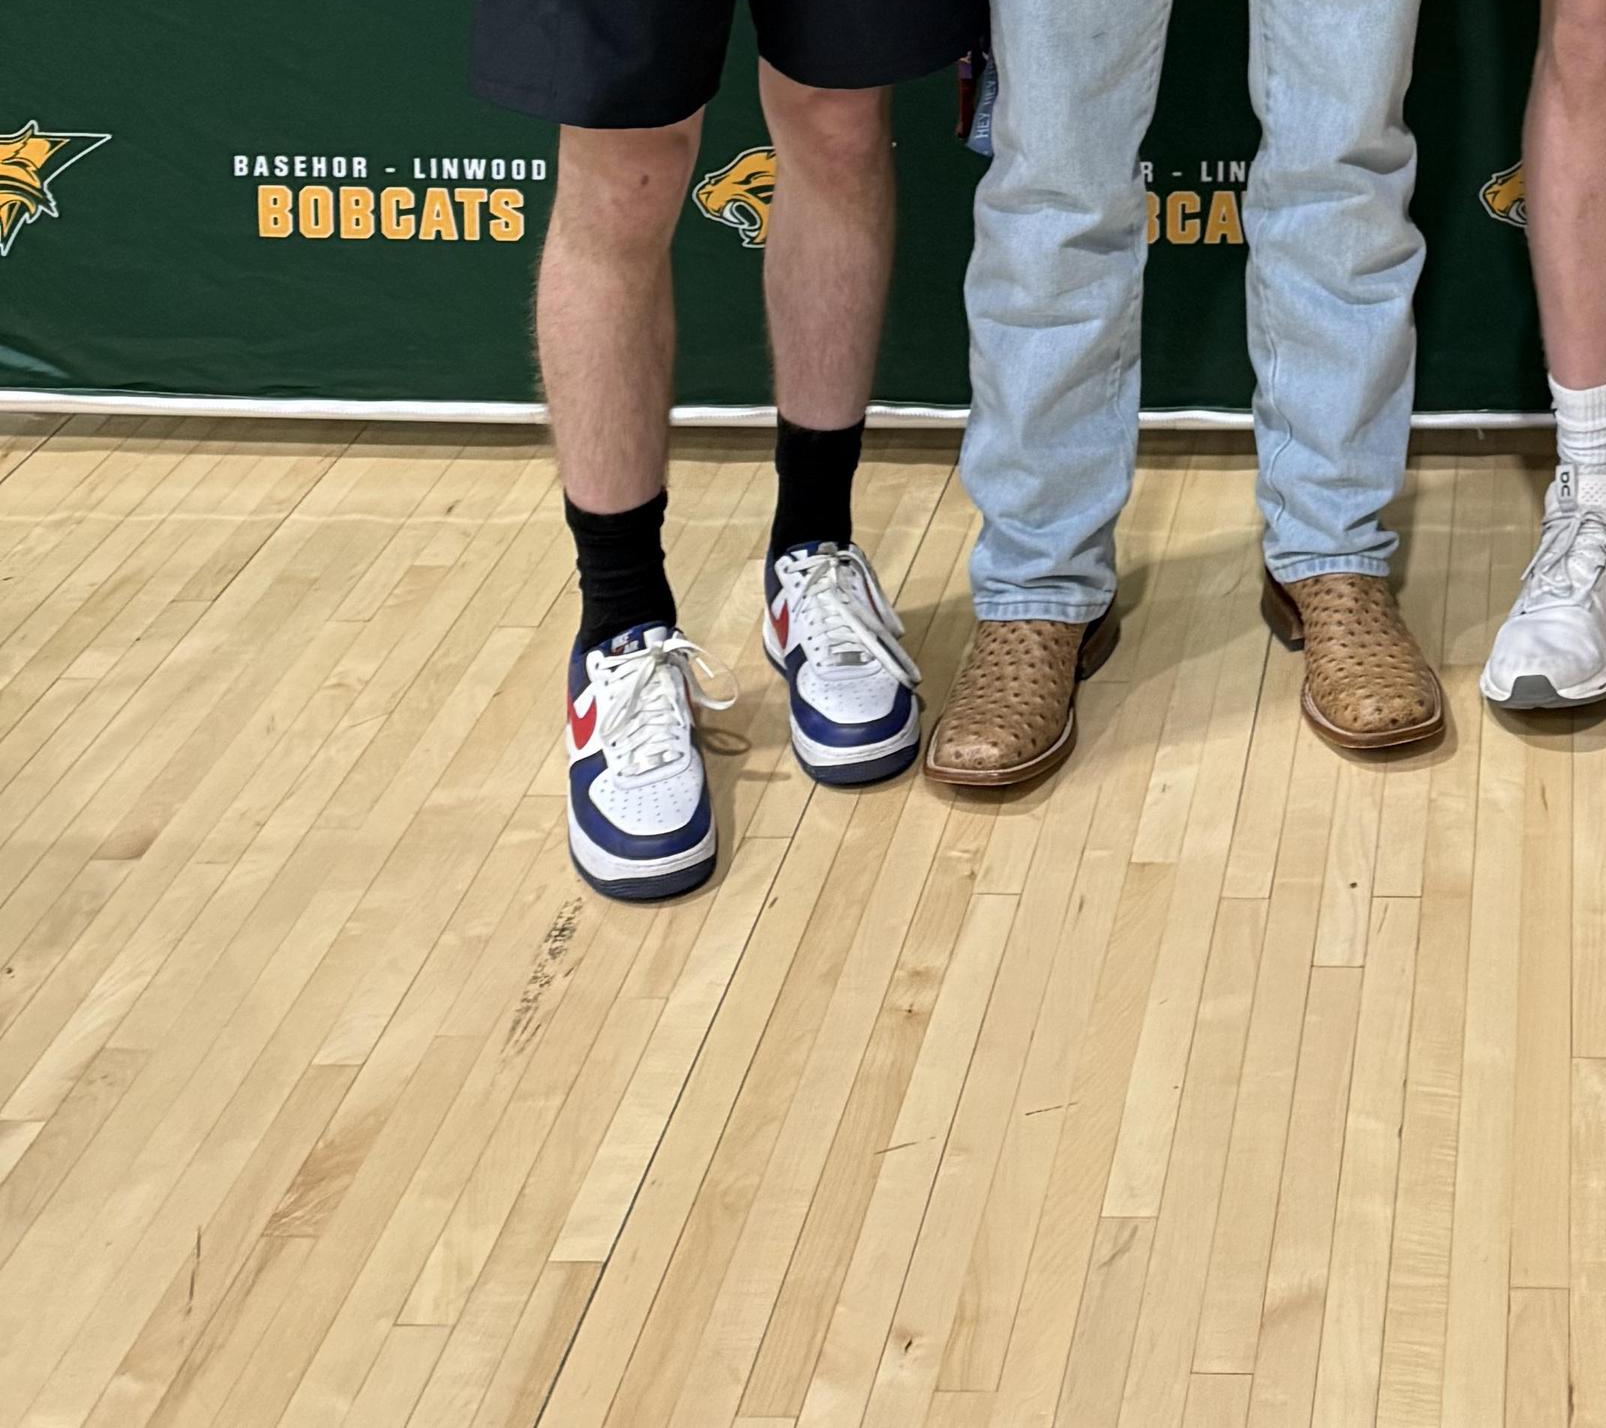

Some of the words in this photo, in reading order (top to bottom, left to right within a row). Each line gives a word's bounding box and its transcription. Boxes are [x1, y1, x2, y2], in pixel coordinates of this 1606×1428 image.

[233, 154, 368, 178] BASEHOR
[413, 157, 547, 181] LINWOOD
[257, 184, 525, 242] BOBCATS
